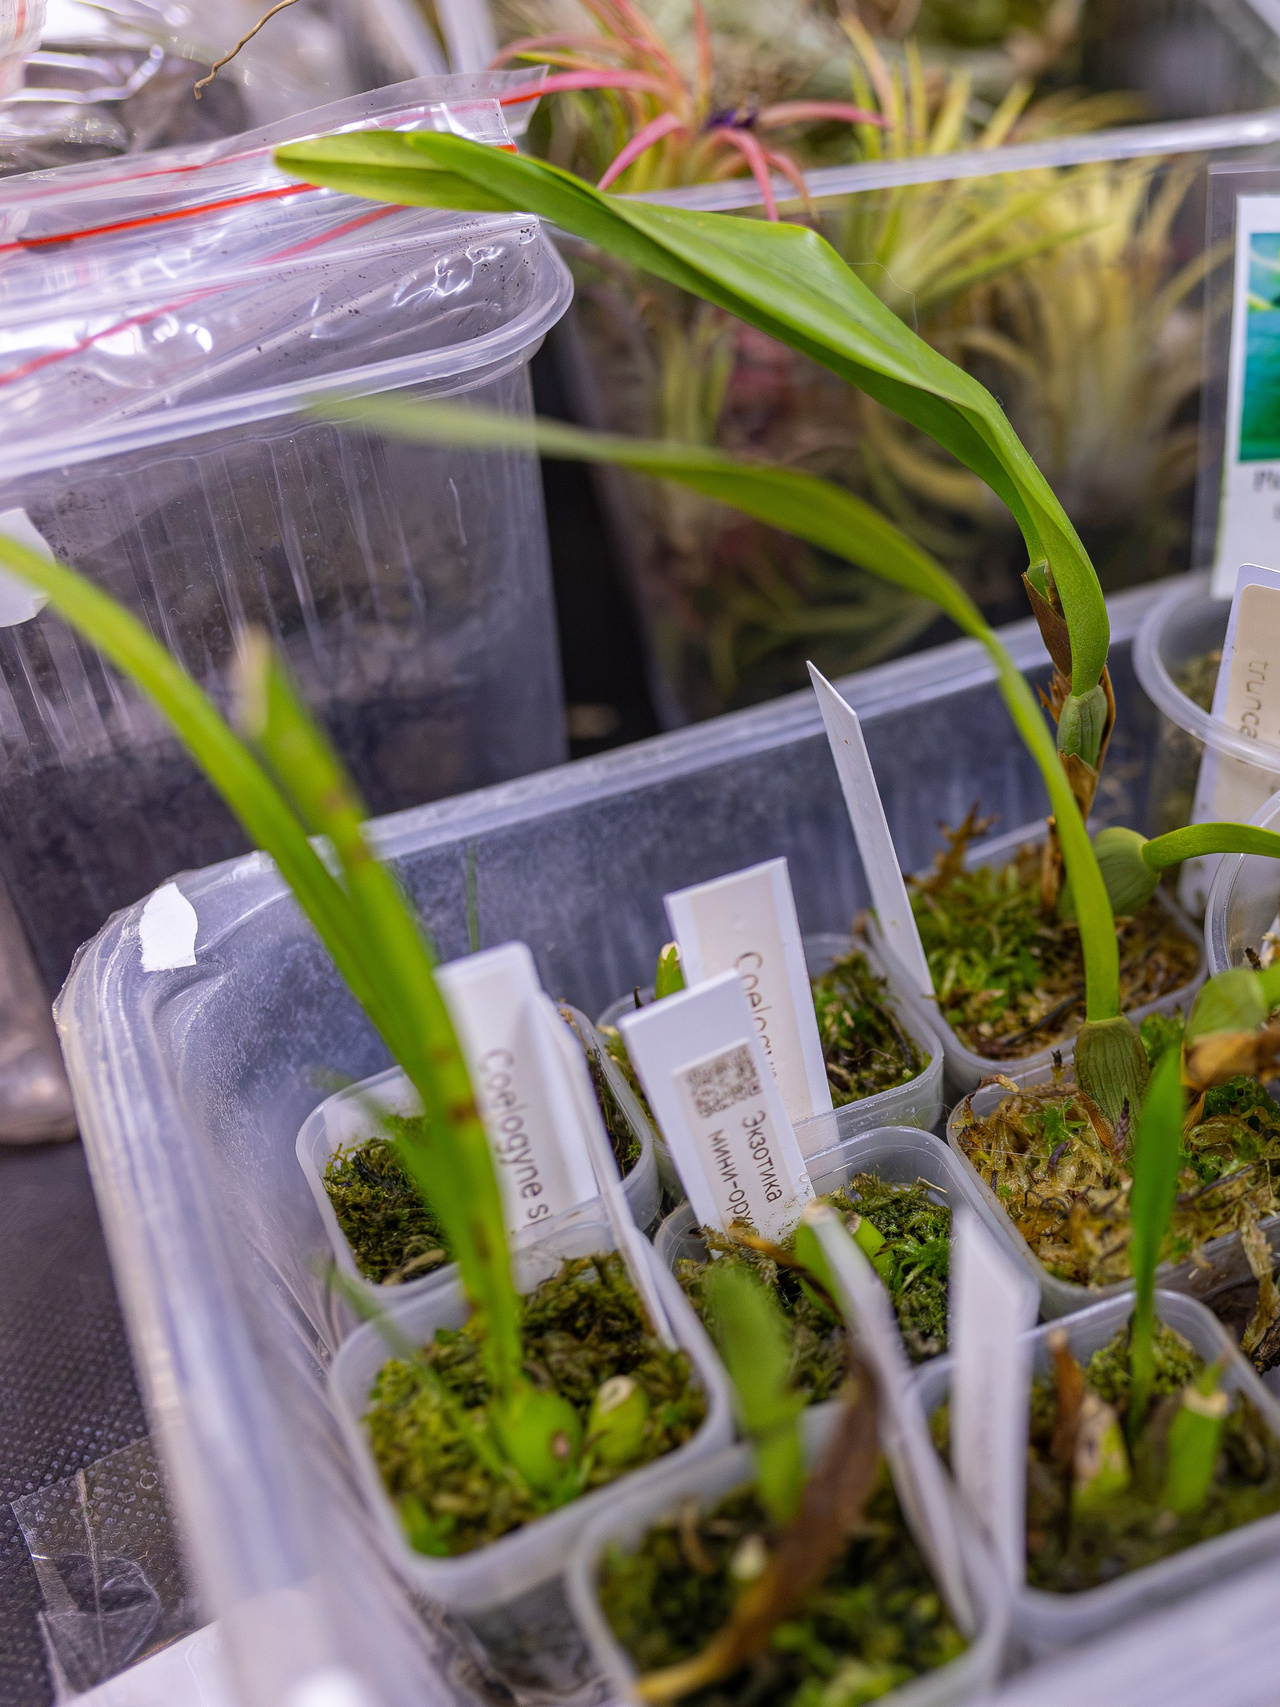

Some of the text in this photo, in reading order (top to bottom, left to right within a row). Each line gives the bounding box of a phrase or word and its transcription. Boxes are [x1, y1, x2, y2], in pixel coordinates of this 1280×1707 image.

[479, 1046, 543, 1199] Coelogyne
[741, 1109, 783, 1204] Экзотика
[707, 1128, 755, 1226] мини-орх
